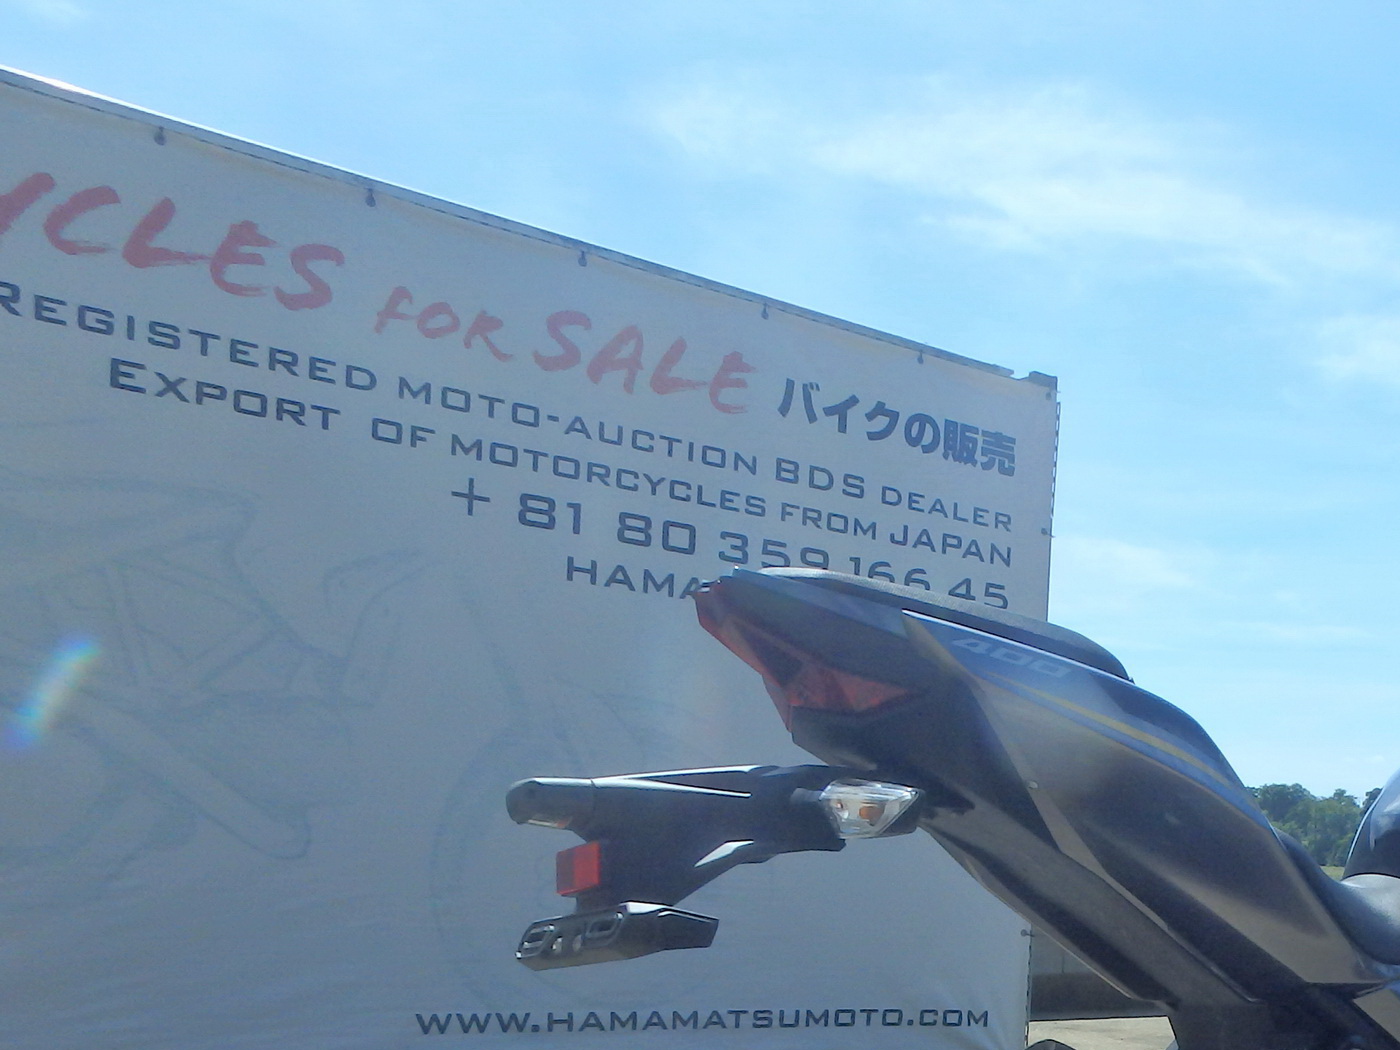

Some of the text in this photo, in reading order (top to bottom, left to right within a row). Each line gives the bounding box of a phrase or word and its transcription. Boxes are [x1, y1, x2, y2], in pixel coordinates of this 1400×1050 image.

[0, 281, 1012, 532] REGISTERED MOTO-AUCTION BDS DEALER
[532, 310, 756, 414] SALE
[778, 378, 1017, 476] バイクの販売
[371, 418, 436, 448] OF
[450, 434, 766, 518] MOTORCYCLES
[780, 504, 877, 540] FROM
[890, 525, 1012, 568] JAPAN
[518, 494, 582, 535] 81
[617, 513, 697, 556] 80
[718, 530, 830, 570] 359
[948, 577, 1009, 609] 45
[415, 1008, 990, 1035] WWW.HAMAMATSUMOTO.COM
